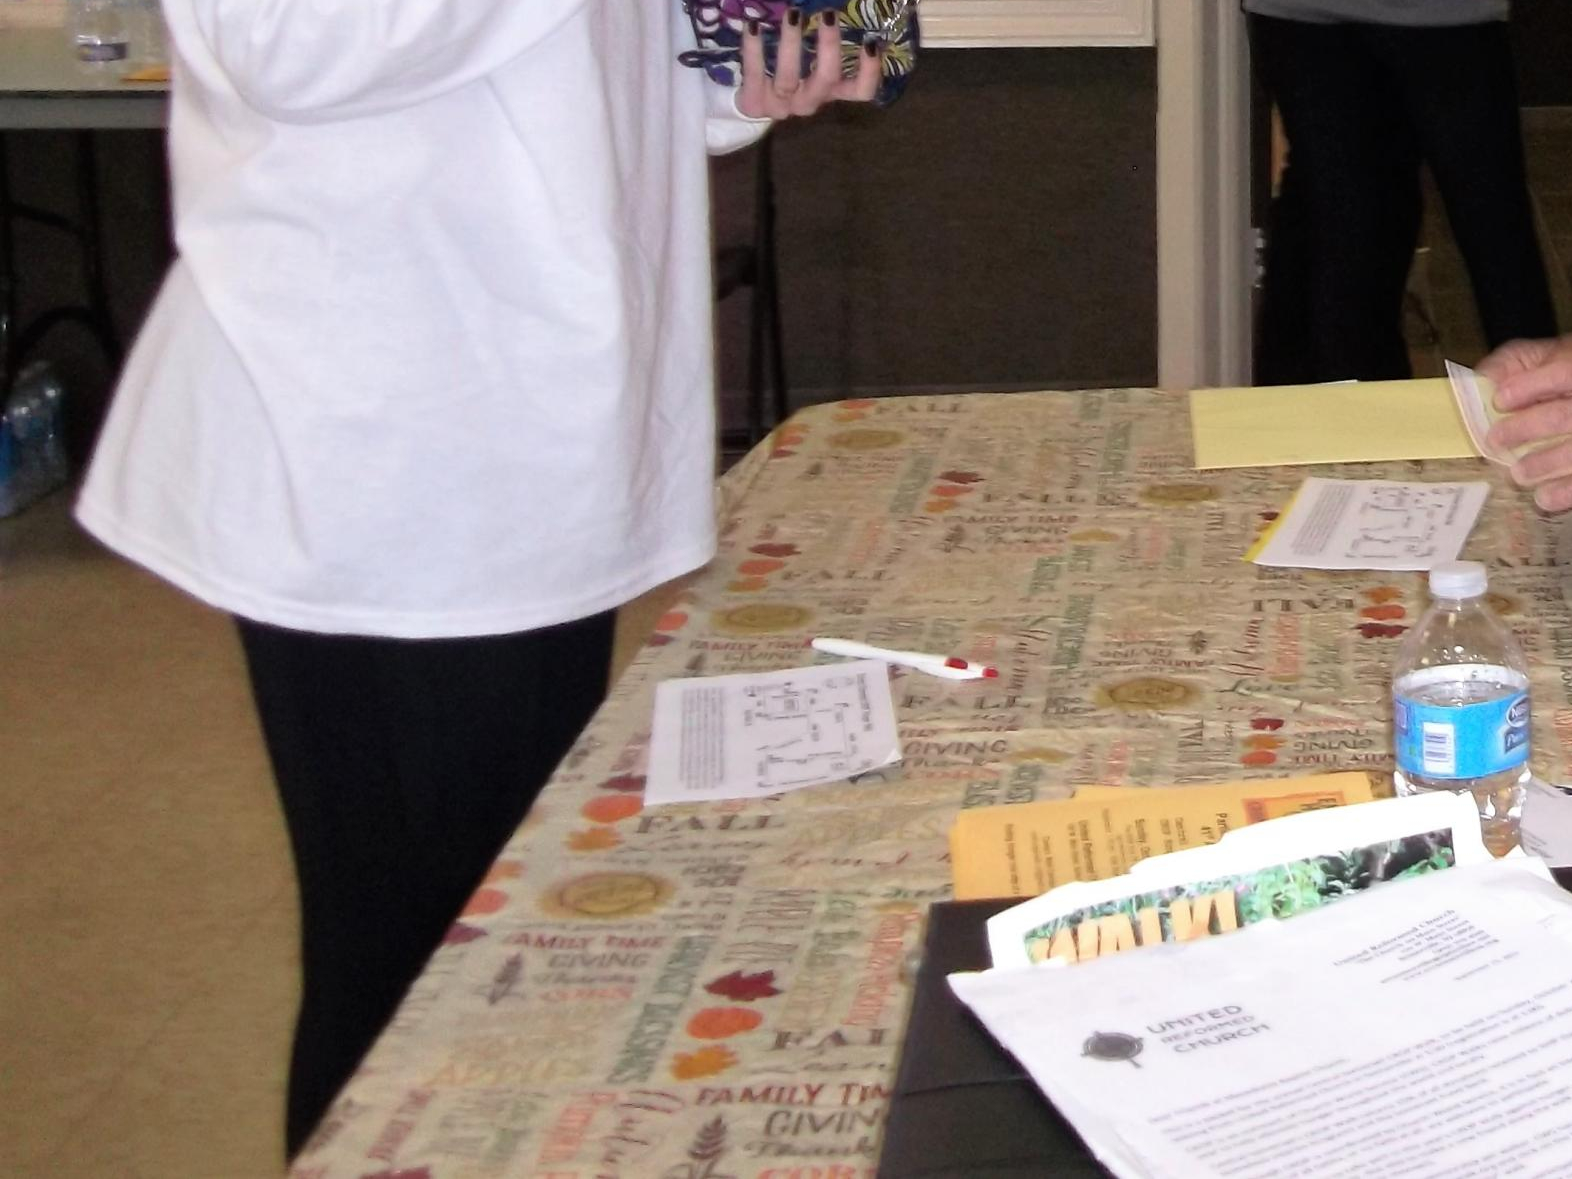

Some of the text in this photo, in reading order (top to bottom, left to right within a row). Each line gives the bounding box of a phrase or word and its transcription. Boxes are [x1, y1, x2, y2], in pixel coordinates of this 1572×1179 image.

[1146, 1004, 1244, 1035] UNITED
[1173, 1022, 1273, 1054] CHURCH
[695, 1082, 827, 1107] FAMILY
[763, 1107, 884, 1138] GIVIN
